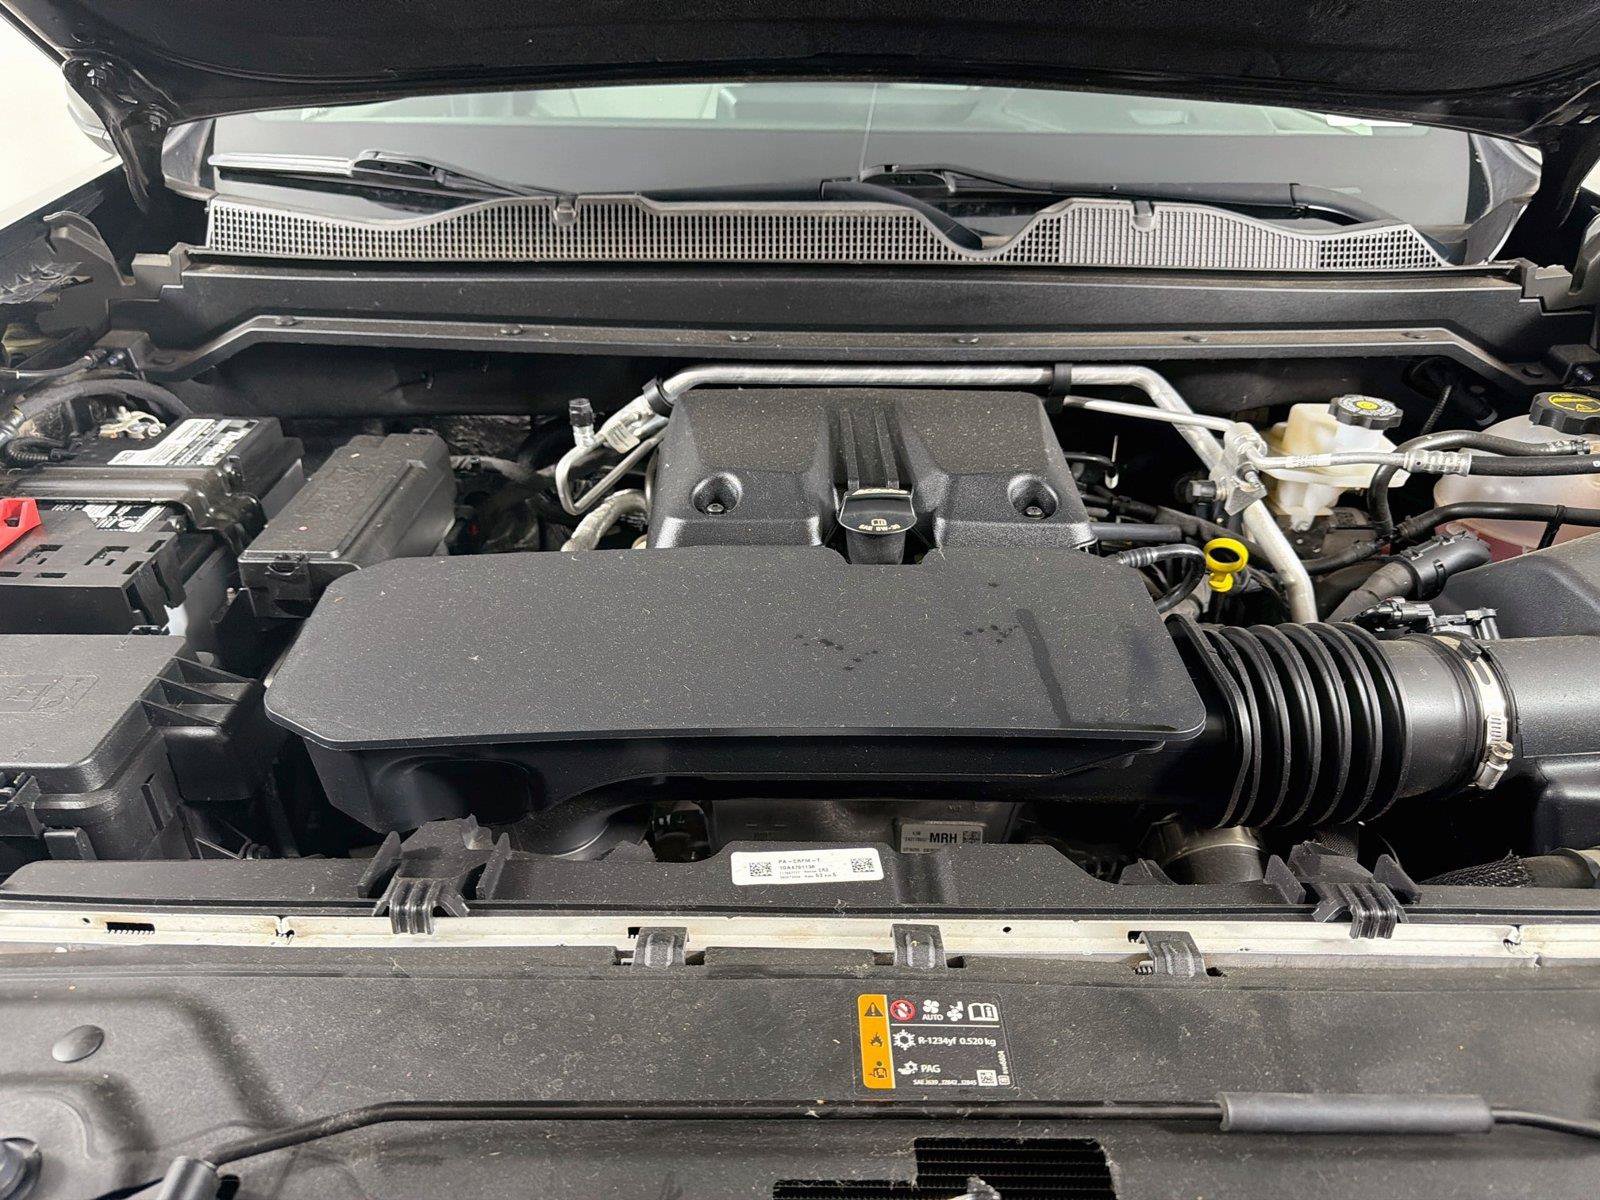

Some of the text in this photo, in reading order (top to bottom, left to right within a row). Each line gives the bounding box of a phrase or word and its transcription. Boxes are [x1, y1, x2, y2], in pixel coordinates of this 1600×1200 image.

[929, 832, 957, 844] MRH
[917, 1036, 997, 1047] R-1234yf 0.520 kg
[920, 1064, 941, 1073] PAG
